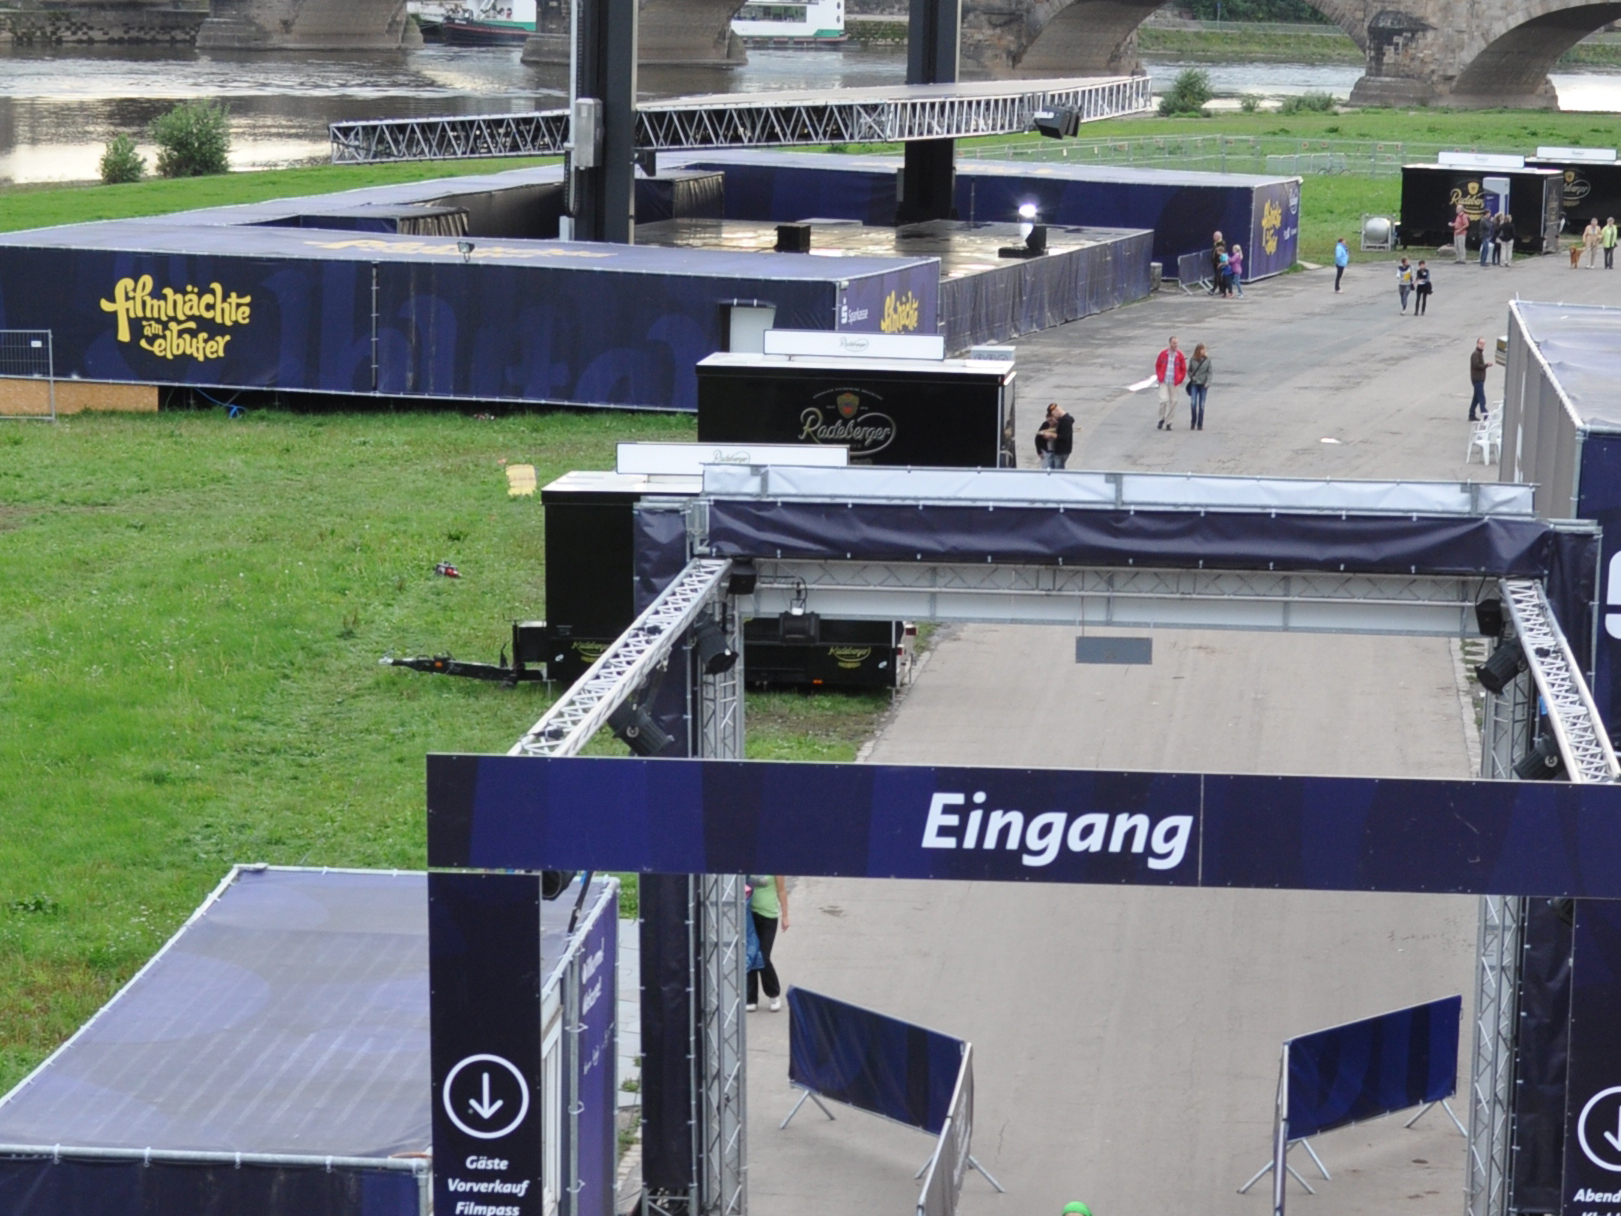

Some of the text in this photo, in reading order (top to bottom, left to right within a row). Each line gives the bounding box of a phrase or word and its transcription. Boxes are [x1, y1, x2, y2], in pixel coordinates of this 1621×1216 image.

[100, 274, 252, 342] filmnächte
[139, 321, 231, 361] elbufer
[141, 320, 164, 337] am
[798, 407, 896, 454] Radeberger
[921, 791, 1194, 870] Eingang
[465, 1155, 509, 1170] Gäste
[447, 1178, 530, 1198] Vorverkauf
